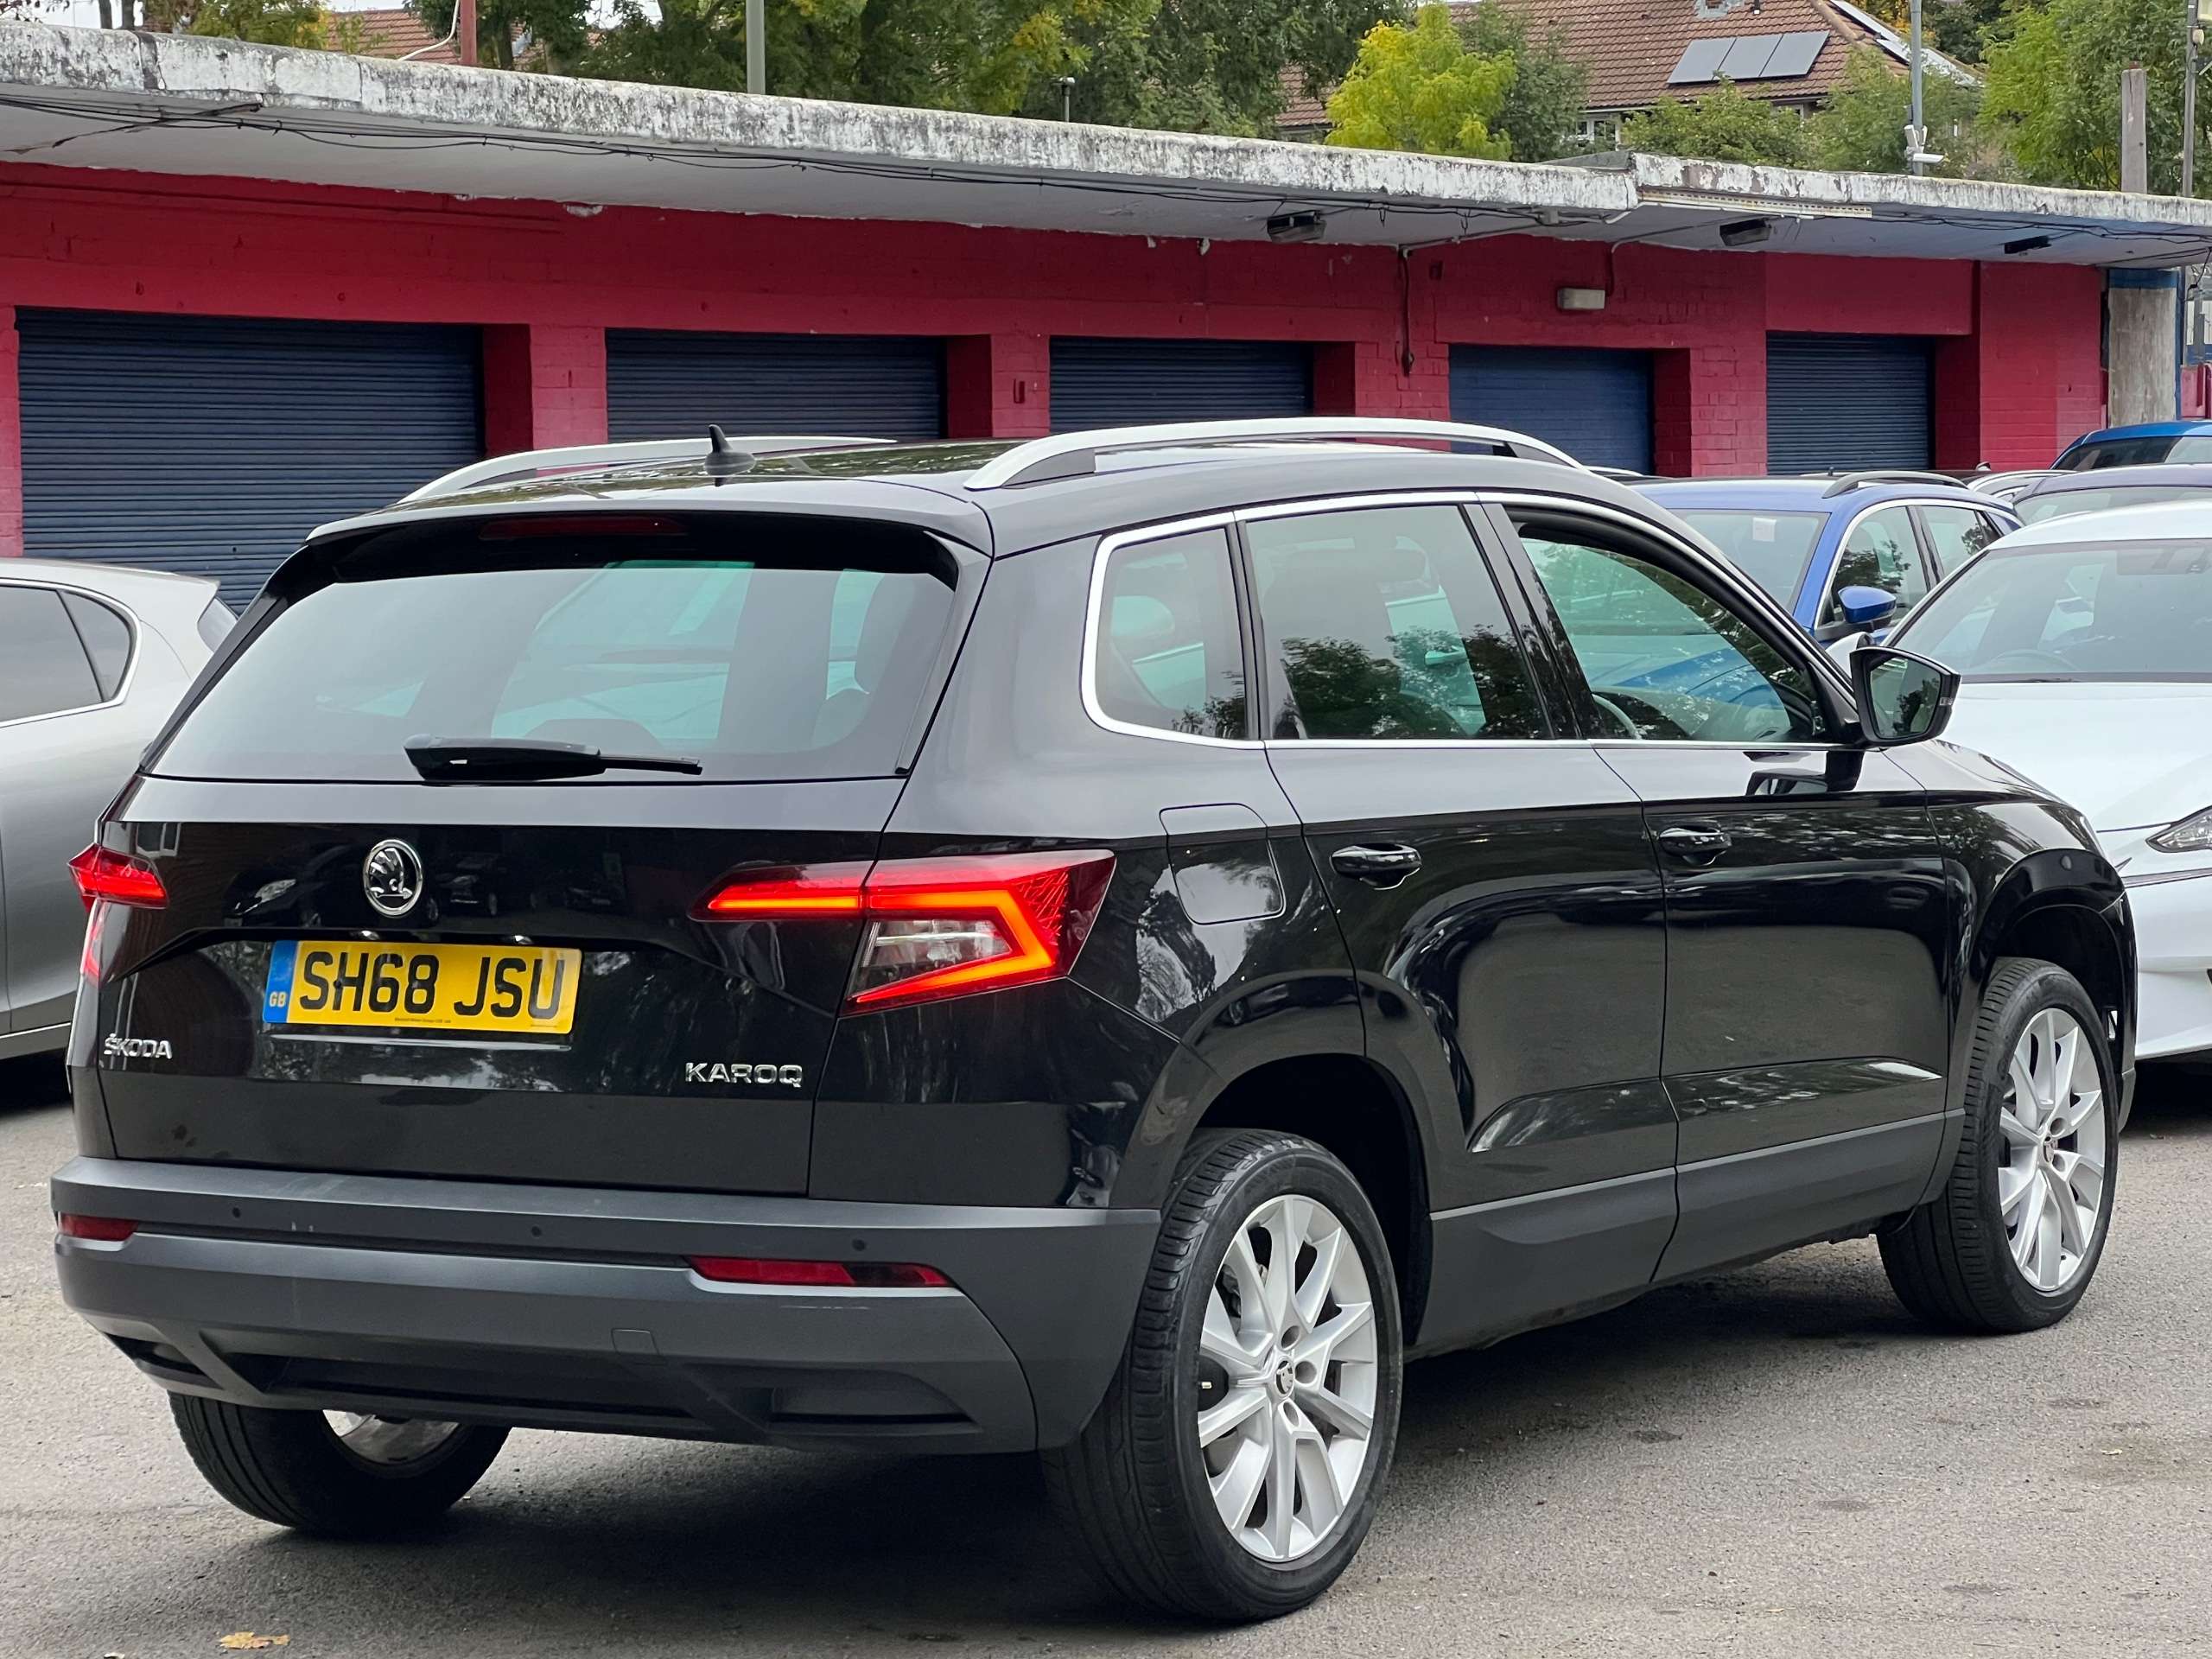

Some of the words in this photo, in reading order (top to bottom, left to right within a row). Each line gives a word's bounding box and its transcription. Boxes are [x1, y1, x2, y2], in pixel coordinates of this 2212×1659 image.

[300, 951, 439, 1014] SH68
[454, 957, 565, 1020] JSU
[270, 991, 287, 1007] GB
[104, 1033, 172, 1059] ŠKODA
[685, 1062, 803, 1088] KAROQ
